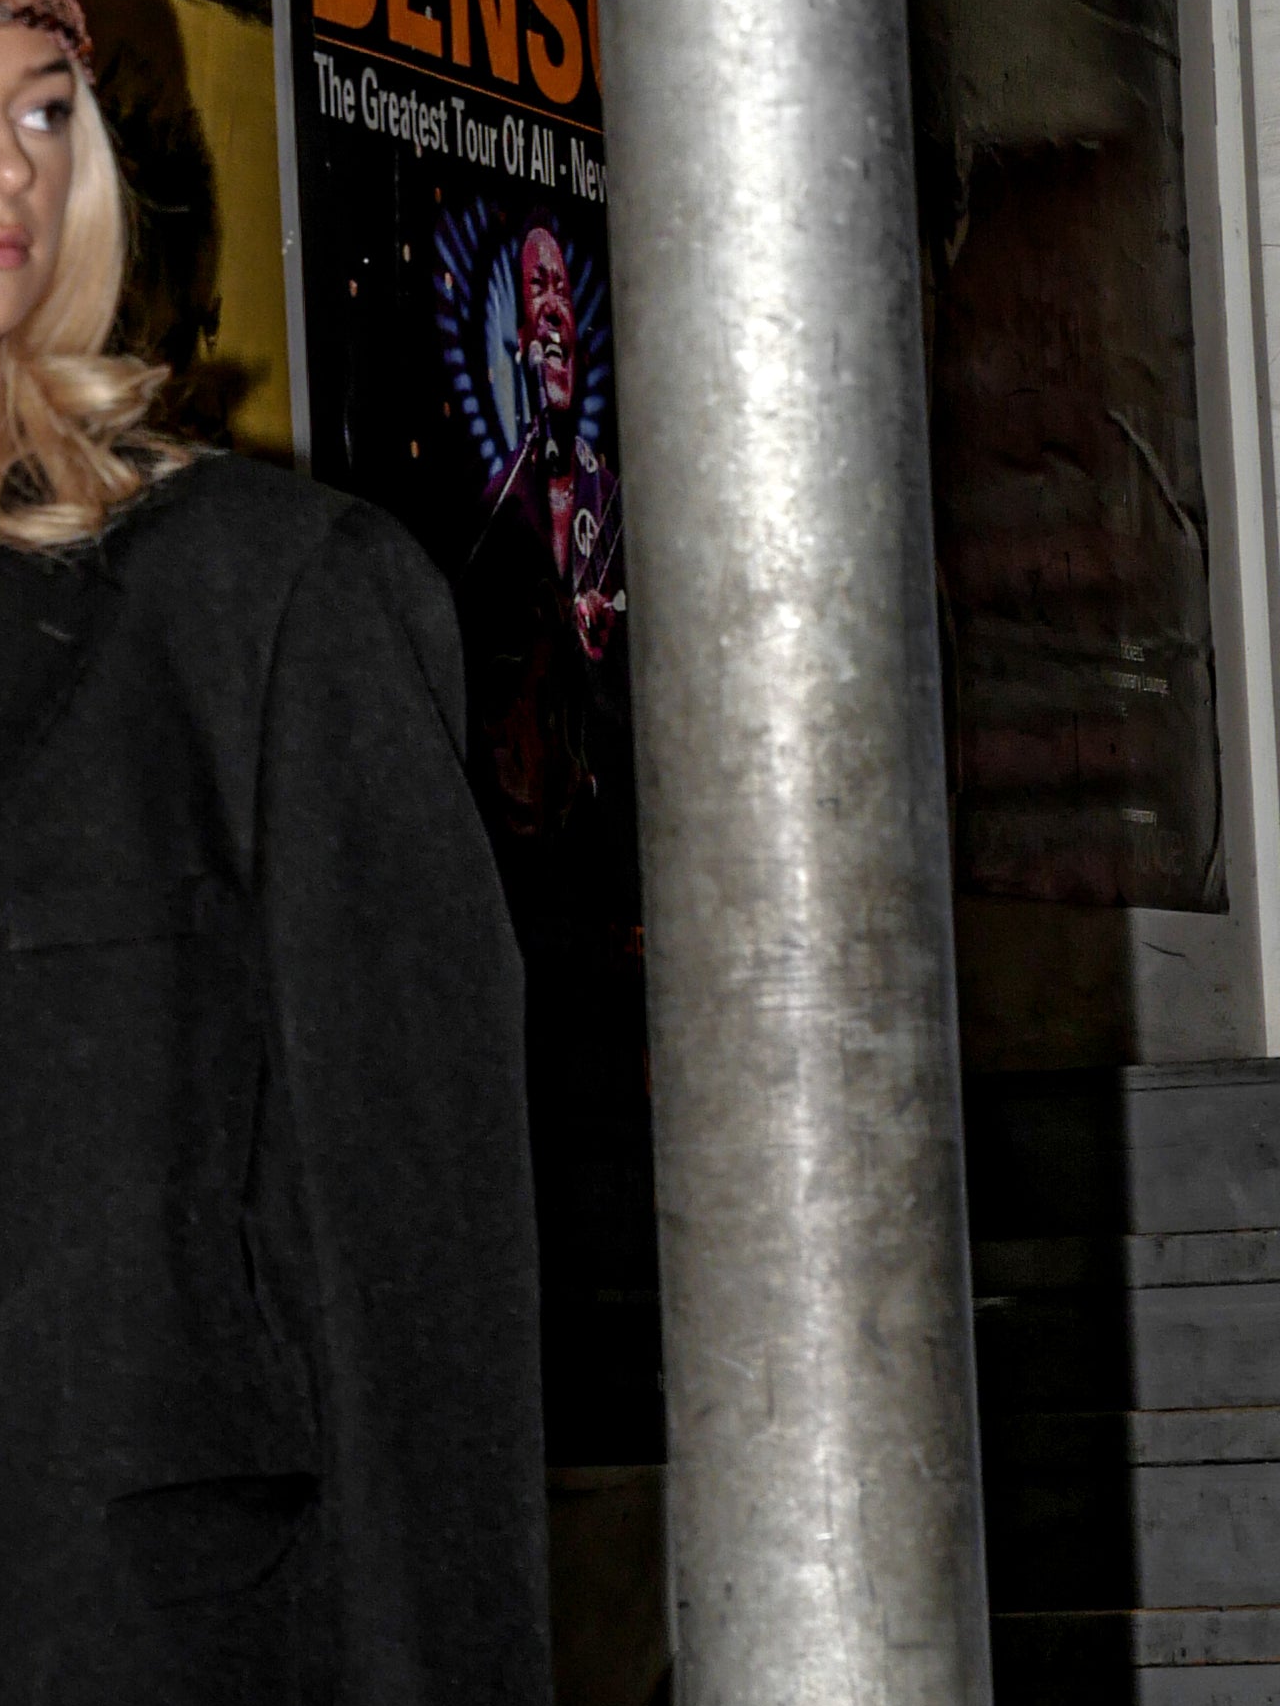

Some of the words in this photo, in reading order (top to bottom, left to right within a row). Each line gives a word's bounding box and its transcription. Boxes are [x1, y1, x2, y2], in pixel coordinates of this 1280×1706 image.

[313, 50, 356, 125] The
[360, 67, 449, 155] Greatest
[451, 95, 499, 169] Tour
[501, 114, 526, 178] Of
[529, 124, 556, 189] All
